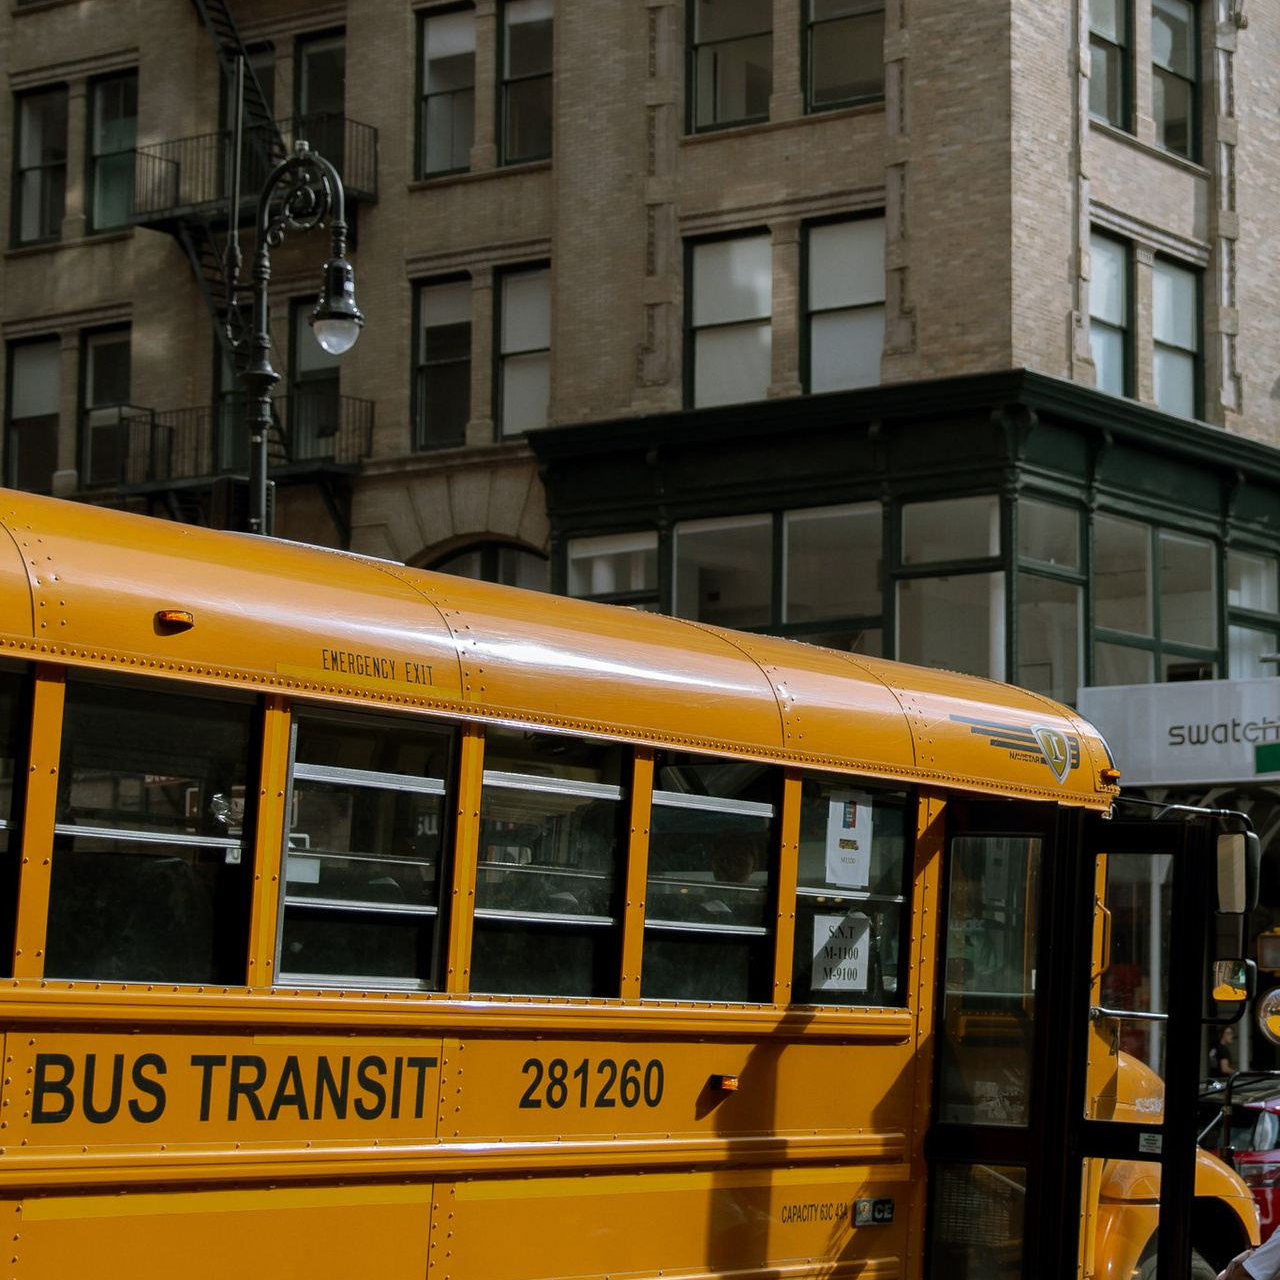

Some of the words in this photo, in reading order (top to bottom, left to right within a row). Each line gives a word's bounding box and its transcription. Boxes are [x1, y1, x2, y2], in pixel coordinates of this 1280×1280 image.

[321, 648, 396, 681] EMERGENCY
[404, 661, 434, 686] EXIT
[828, 926, 857, 940] S.N.T
[823, 945, 860, 961] M-1100
[822, 965, 859, 982] M-9100
[31, 1052, 167, 1124] BUS
[190, 1054, 438, 1122] TRANSIT
[519, 1058, 665, 1110] 281260
[781, 1203, 819, 1224] CAPACITY
[820, 1202, 834, 1221] 63C
[874, 1202, 893, 1219] CE
